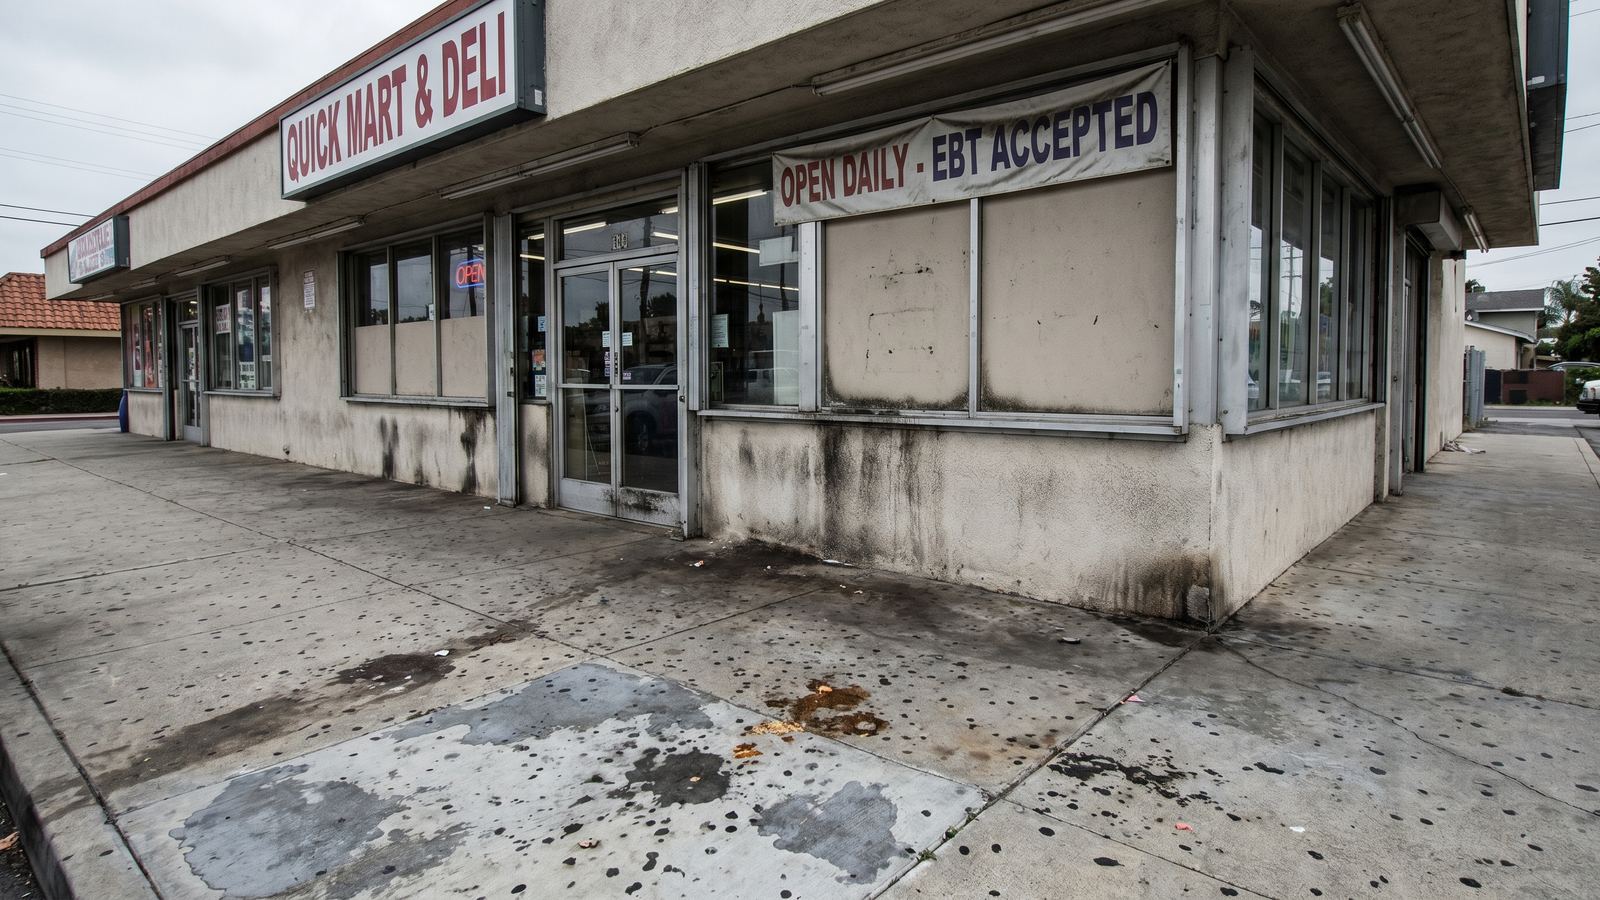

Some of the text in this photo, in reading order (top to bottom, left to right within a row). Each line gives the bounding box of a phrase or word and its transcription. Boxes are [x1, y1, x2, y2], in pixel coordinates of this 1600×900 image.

[287, 11, 506, 183] QUICK MART & DELI
[781, 157, 836, 208] OPEN
[843, 142, 910, 197] DAILY
[932, 127, 983, 182] EBT
[991, 90, 1158, 172] ACCEPTED
[456, 263, 485, 285] OPEN
